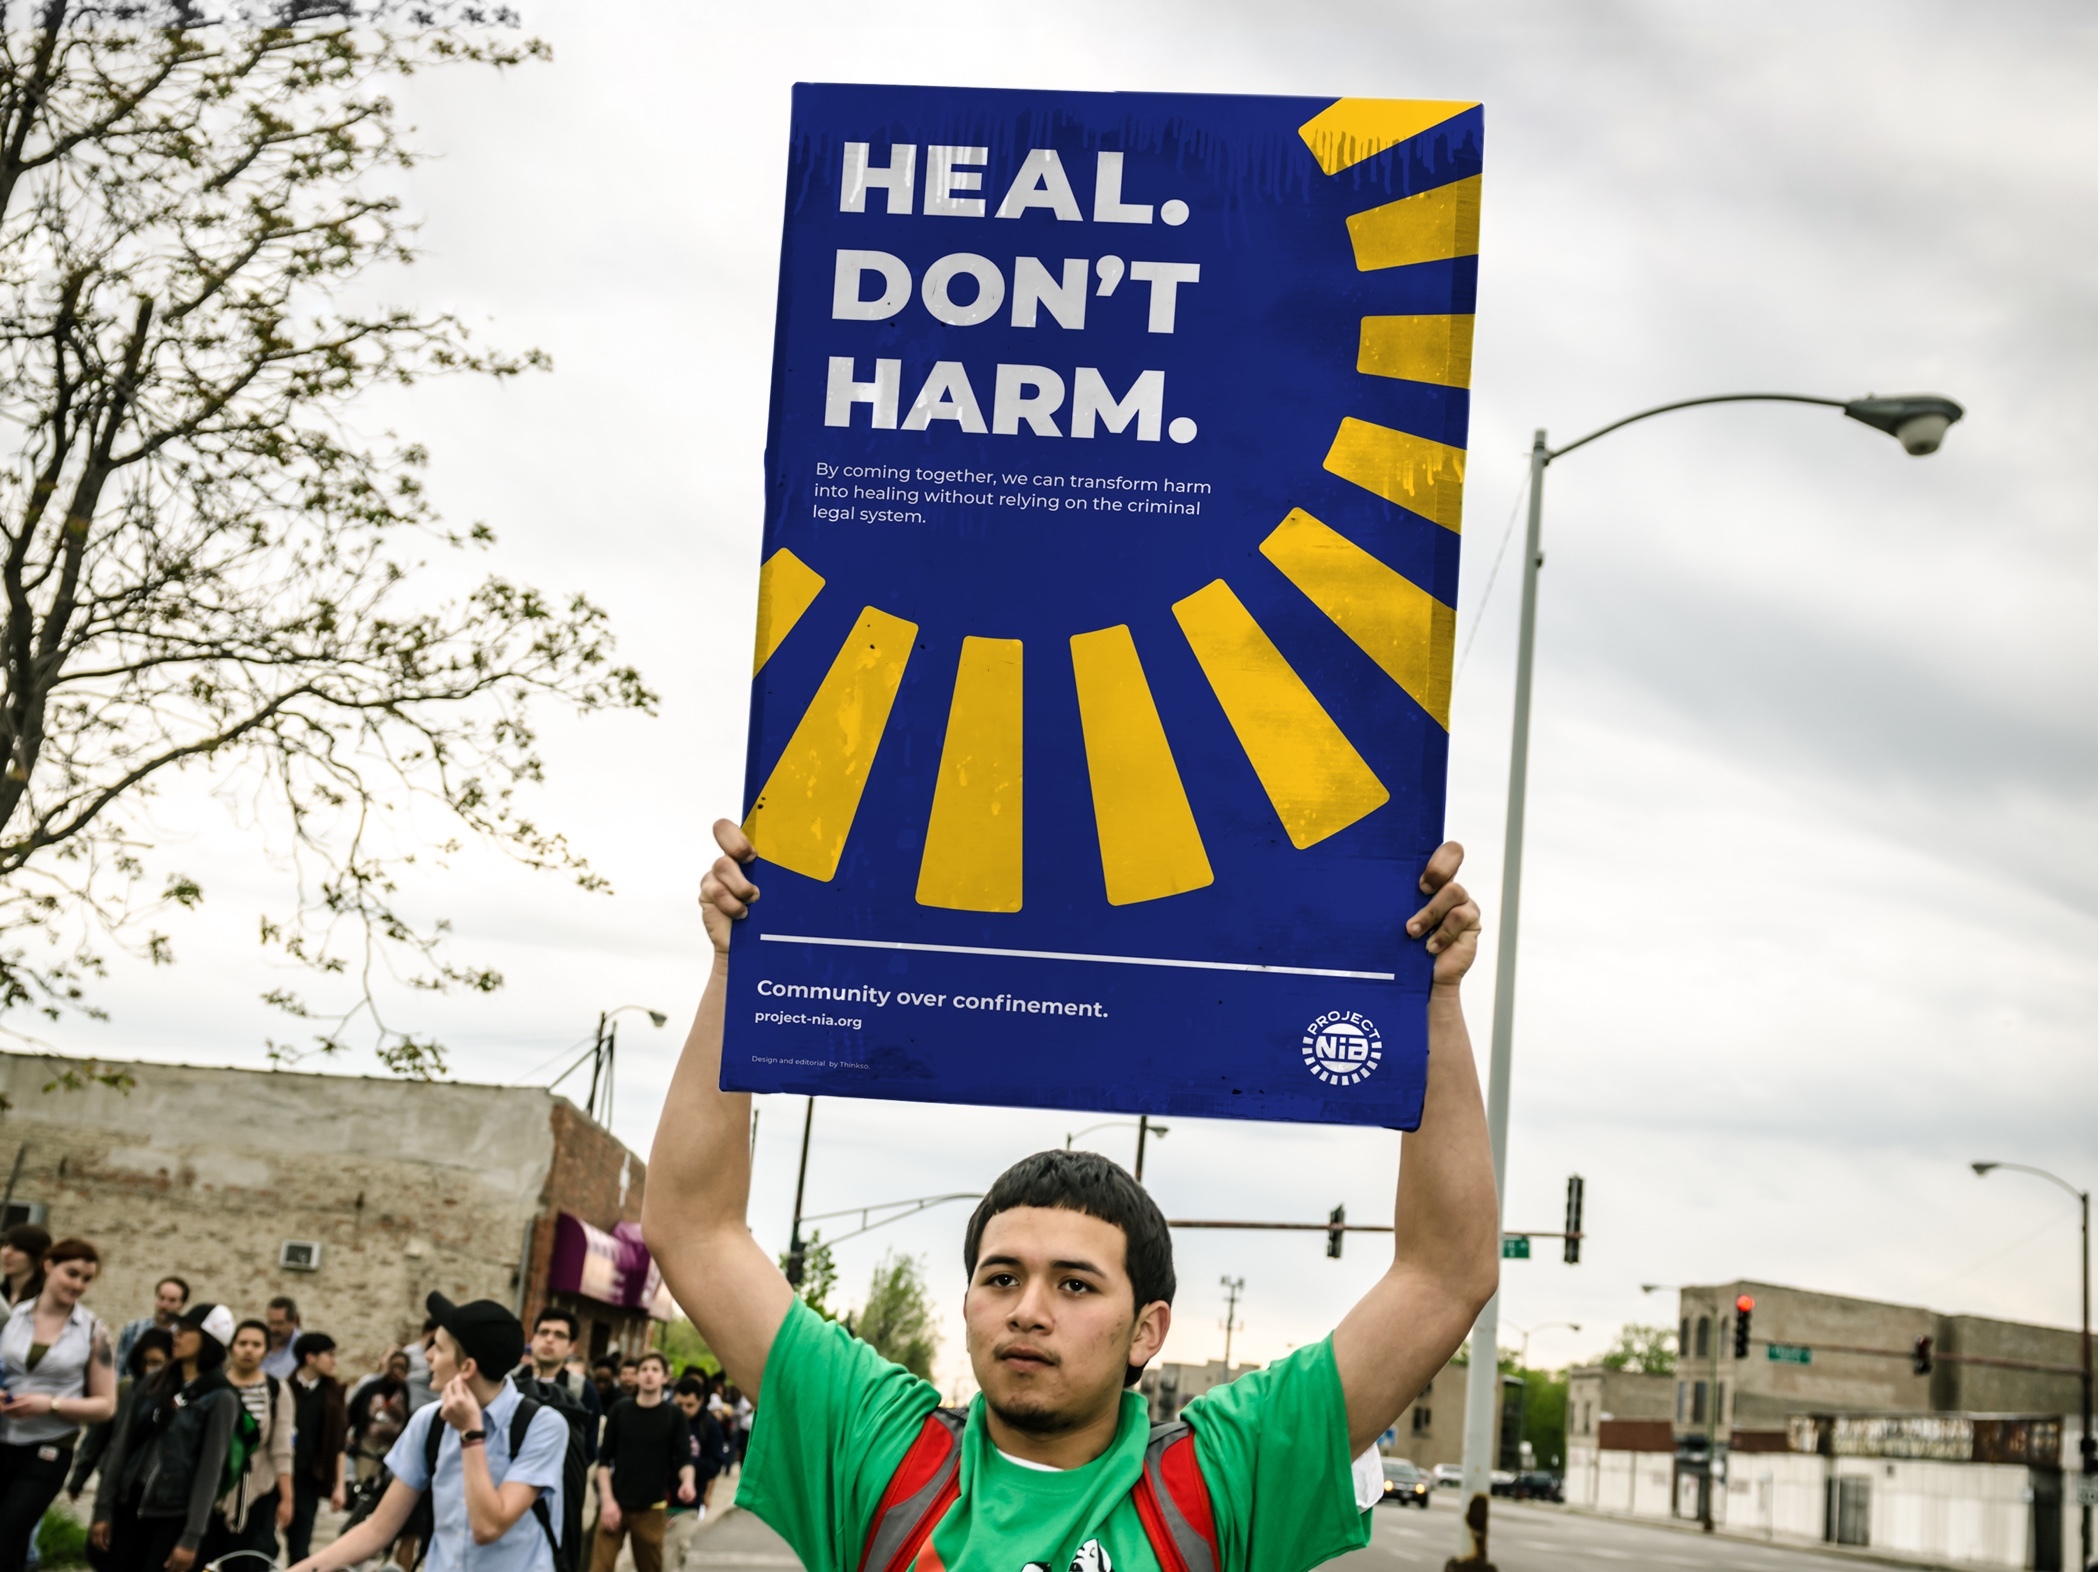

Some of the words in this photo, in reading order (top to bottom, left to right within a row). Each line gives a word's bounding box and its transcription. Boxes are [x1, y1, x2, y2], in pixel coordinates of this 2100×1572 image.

[840, 142, 1189, 225] HEAL.
[825, 357, 1197, 443] HARM.
[816, 463, 840, 480] By
[843, 466, 911, 483] coming
[915, 467, 997, 486] together,
[1001, 473, 1028, 485] we
[1032, 475, 1065, 487] can
[1069, 475, 1158, 492] transform
[1163, 477, 1212, 494] harm
[812, 504, 855, 523] legal
[859, 509, 926, 525] system.
[814, 482, 849, 498] into
[853, 484, 919, 505] healing
[923, 488, 994, 506] without
[999, 492, 1060, 512] relying
[1064, 498, 1088, 510] on
[1092, 497, 1123, 512] the
[1127, 498, 1201, 516] criminal
[756, 979, 892, 1008] Community
[896, 991, 947, 1007] over
[952, 993, 1109, 1018] confinement.
[754, 1010, 863, 1031] project-nia.org
[1306, 1010, 1381, 1040] PROJECT
[751, 1055, 778, 1065] Design
[778, 1057, 794, 1065] and
[794, 1059, 826, 1067] editorial
[828, 1060, 839, 1069] by
[839, 1061, 871, 1071] Thinkso.
